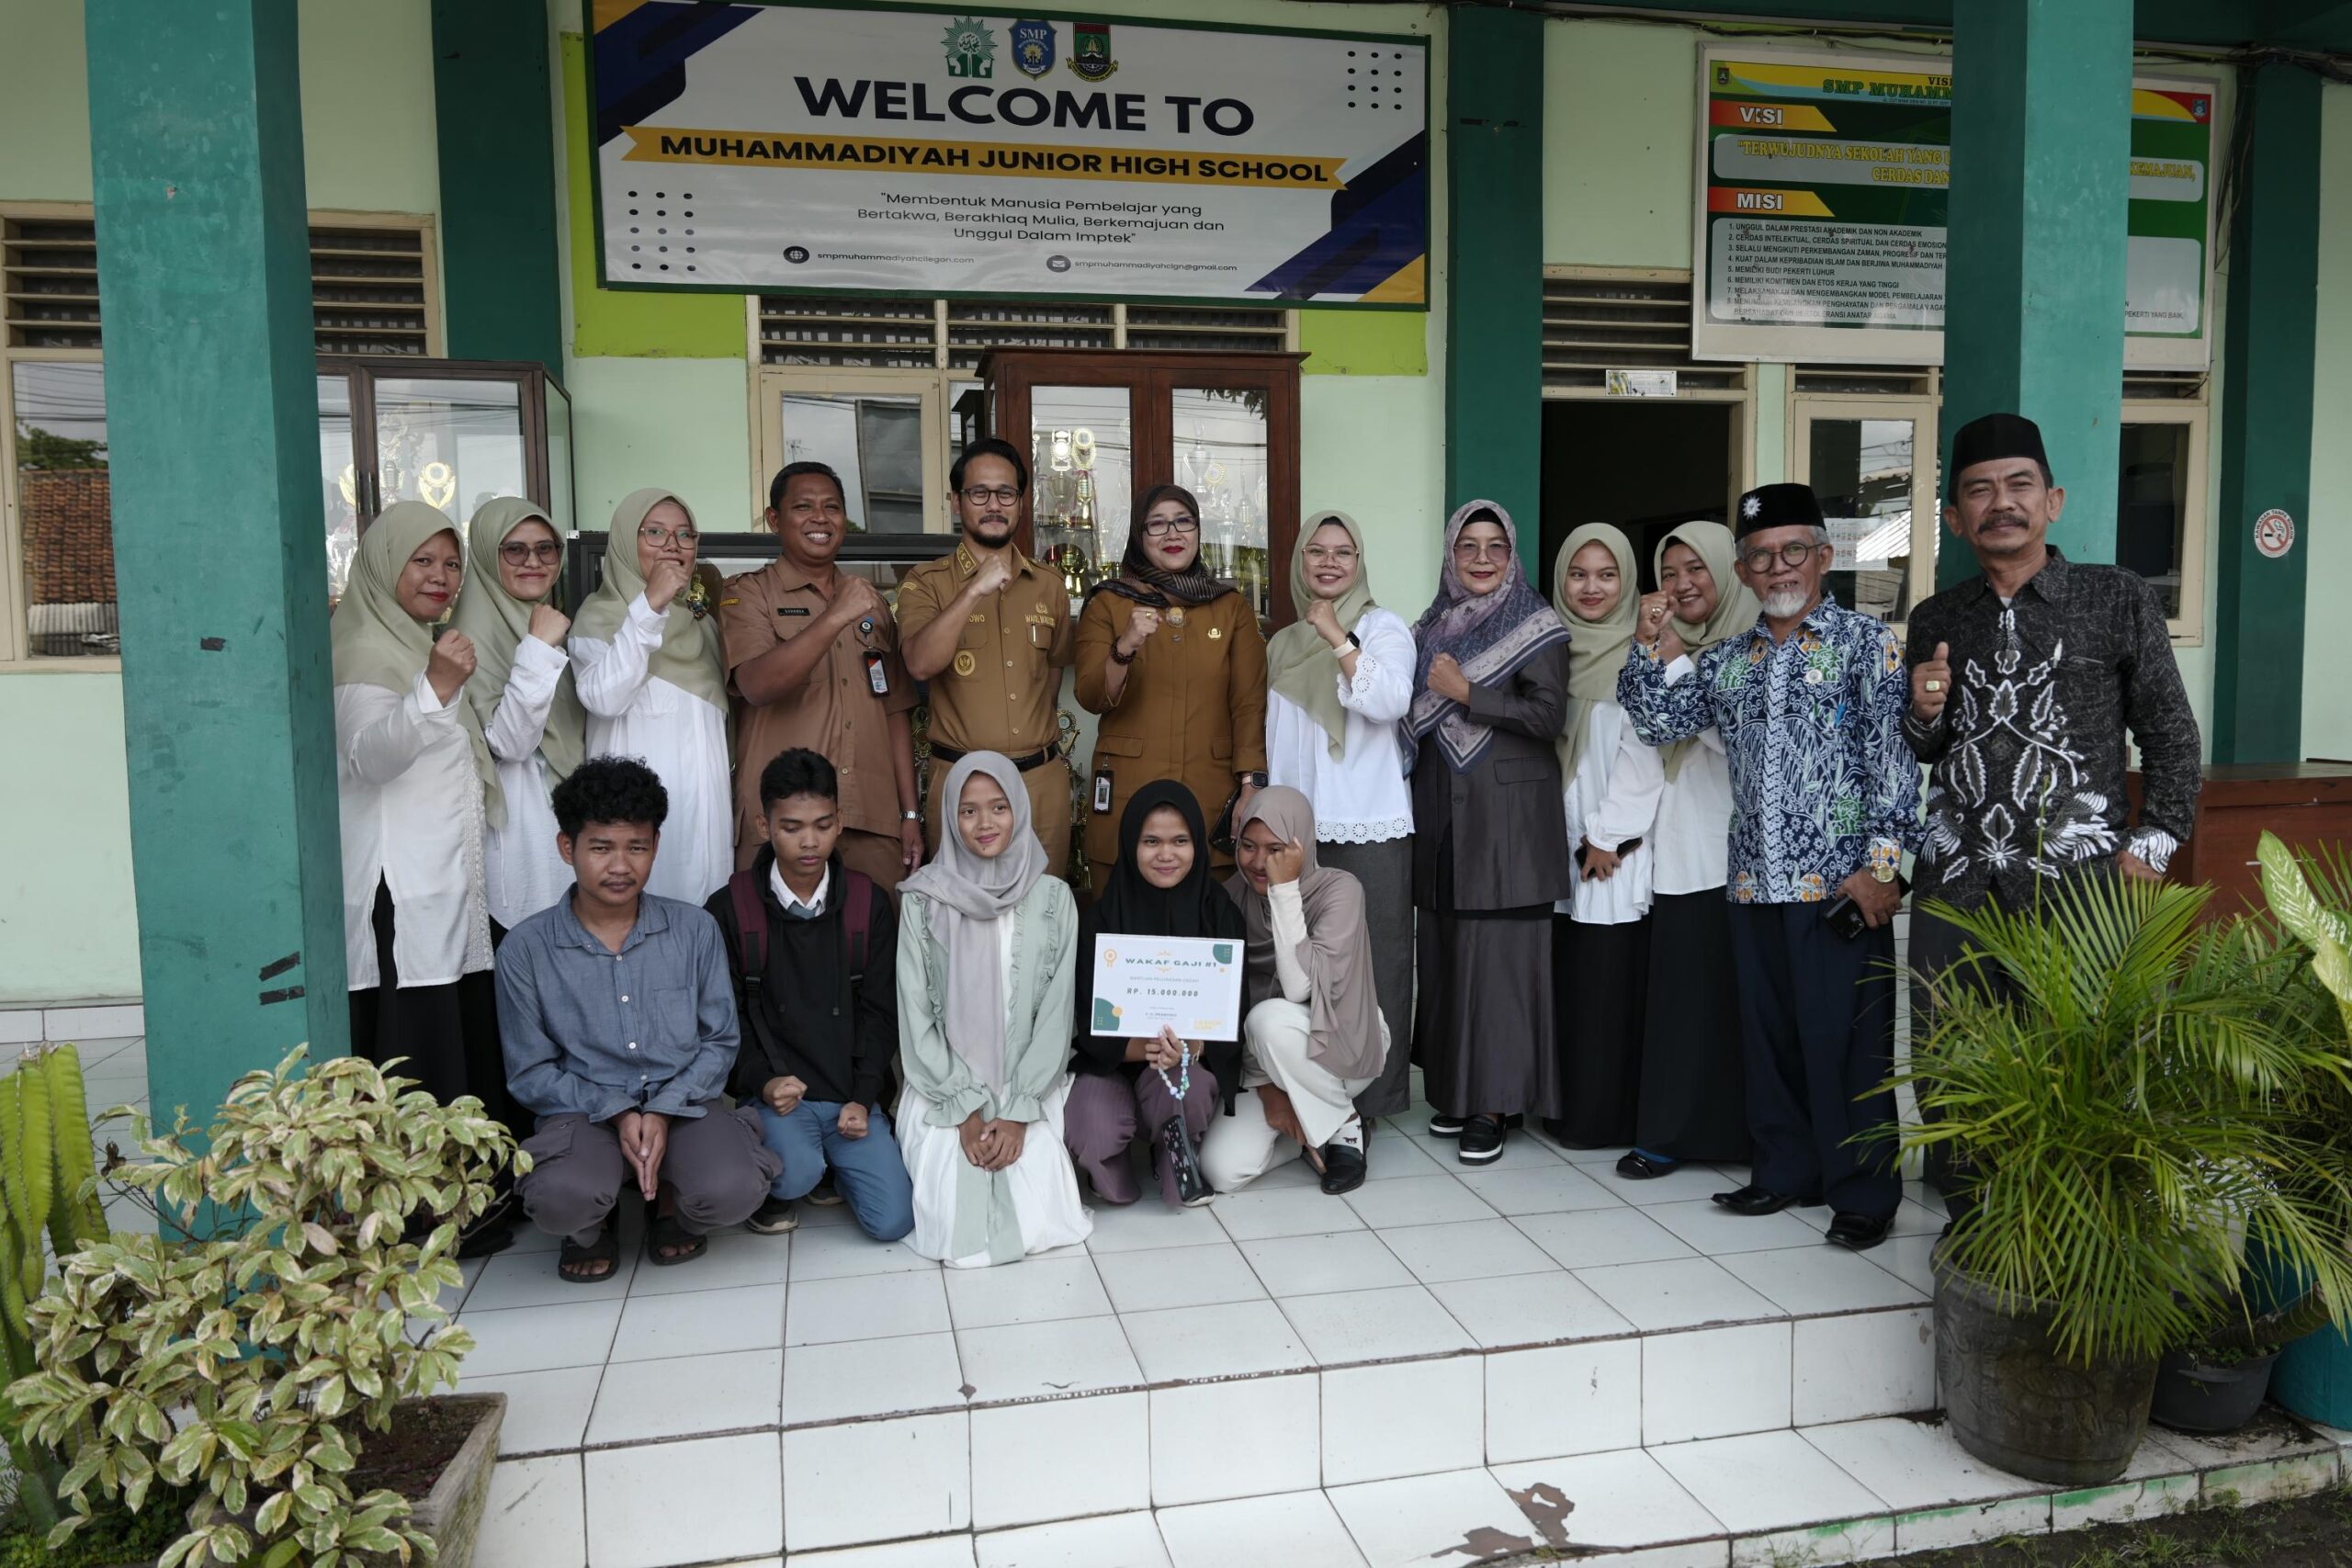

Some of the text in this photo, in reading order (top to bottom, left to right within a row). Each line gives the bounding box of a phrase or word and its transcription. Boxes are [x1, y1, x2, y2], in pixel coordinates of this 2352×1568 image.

[1020, 28, 1047, 39] SMP
[1823, 79, 1952, 99] SMP MUHAMM
[794, 76, 1254, 137] WELCOME TO
[1739, 106, 1783, 125] VISI
[661, 136, 1329, 182] MUHAMMADIYAH JUNIOR HIGH SCHOOL
[1737, 140, 1842, 161] "TERWUJUDNYA
[1845, 145, 1905, 163] SEKOLAH
[1907, 148, 1941, 164] YANG
[1871, 166, 1951, 186] CERDAS DAN
[2130, 161, 2196, 182] KEMAJUAN,
[880, 192, 1203, 218] "Membentuk Manusia Pembelajar yang
[1737, 193, 1783, 210] MISI
[857, 208, 1224, 231] Bertakwa, Berakhlaq Mulia, Berkemajuan dan
[954, 227, 1136, 245] Unggul Dalam Imptek"
[1736, 223, 1763, 231] UNGGUL
[1790, 225, 1822, 233] PRESTASI
[1823, 226, 1858, 235] AKADEMIK
[1889, 230, 1923, 238] AKADEMIK
[1764, 235, 1810, 244] INTELEKTUAL,
[1812, 237, 1839, 245] CERDAS
[1841, 238, 1874, 246] SPIRITUAL
[1890, 240, 1917, 248] CERDAS
[817, 252, 975, 265] smpmuhammadiyahcilegon.com
[1763, 245, 1799, 254] MENGIKUTI
[1801, 246, 1856, 255] PERKEMBANGAN
[1883, 251, 1918, 259] PROGRESIF
[1779, 256, 1824, 265] KEPRIBADIAN
[1891, 261, 1943, 269] MUHAMMADIYAH
[1836, 279, 1858, 288] KERJA
[1806, 289, 1867, 299] MENGEMBANGKAN
[1892, 292, 1943, 300] PEMBELAJARAN
[1822, 300, 1869, 309] PENGHAYATAN
[1147, 988, 1199, 998] 15.000.000
